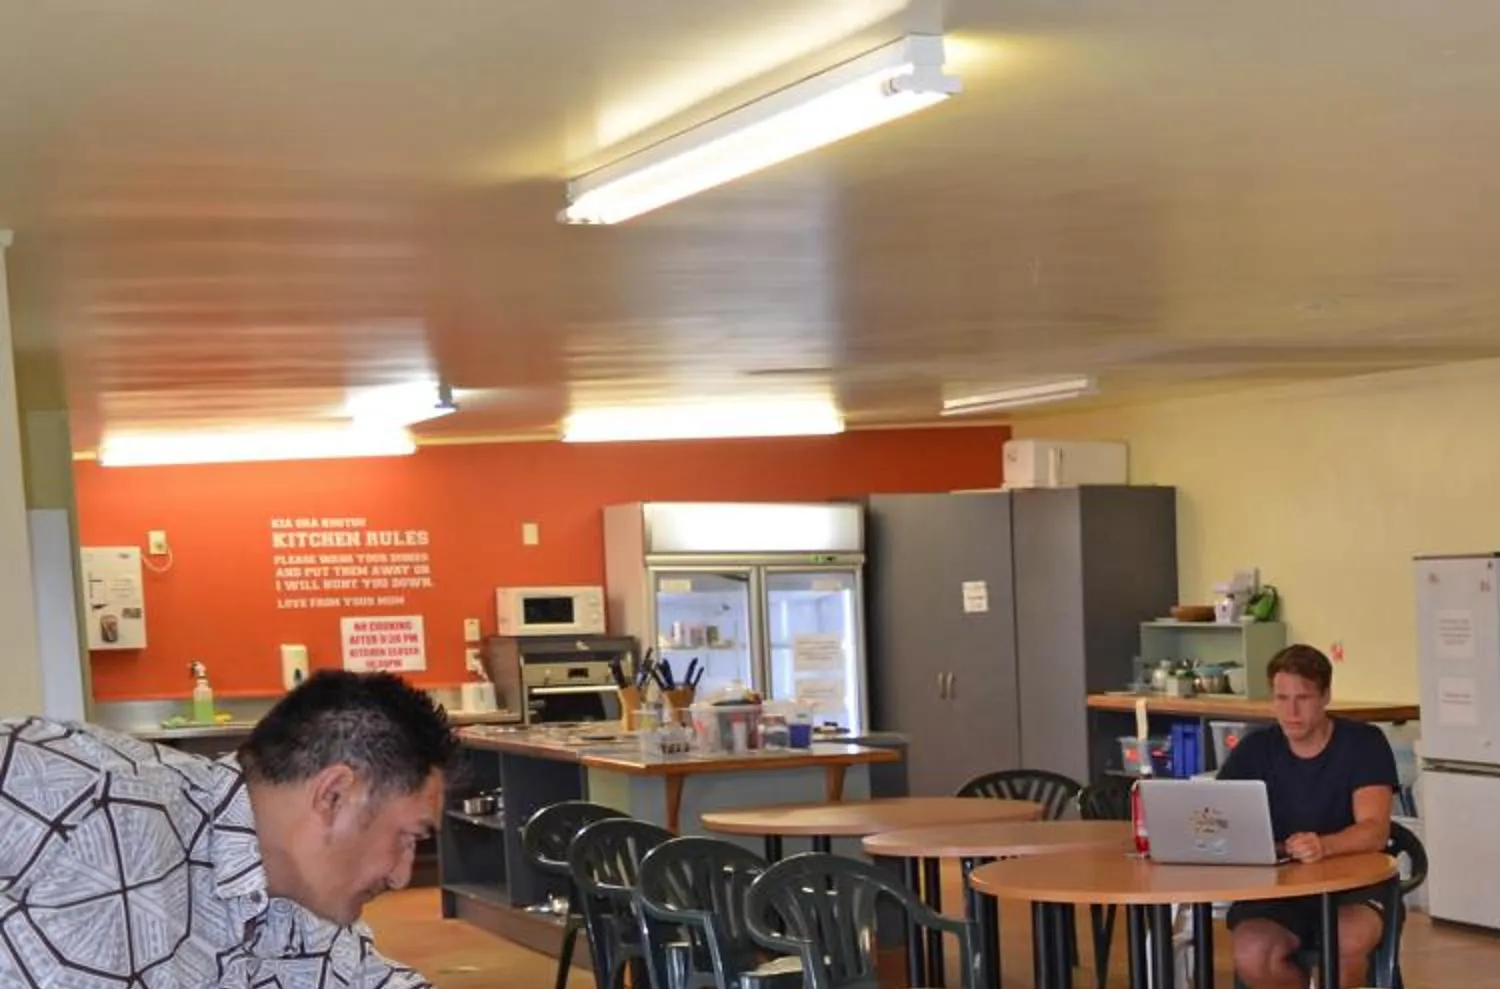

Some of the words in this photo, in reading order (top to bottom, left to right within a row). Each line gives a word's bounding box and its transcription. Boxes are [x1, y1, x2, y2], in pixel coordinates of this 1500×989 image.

[272, 531, 362, 548] KITCHEN
[366, 530, 430, 546] RULES
[276, 567, 302, 577] AND
[304, 566, 330, 576] PUT
[332, 566, 367, 576] THEM
[370, 565, 410, 575] AWAY
[284, 580, 320, 590] WILL
[362, 578, 389, 588] YOU
[369, 621, 413, 631] COOKING
[350, 635, 377, 645] AFTER
[403, 633, 418, 643] PM
